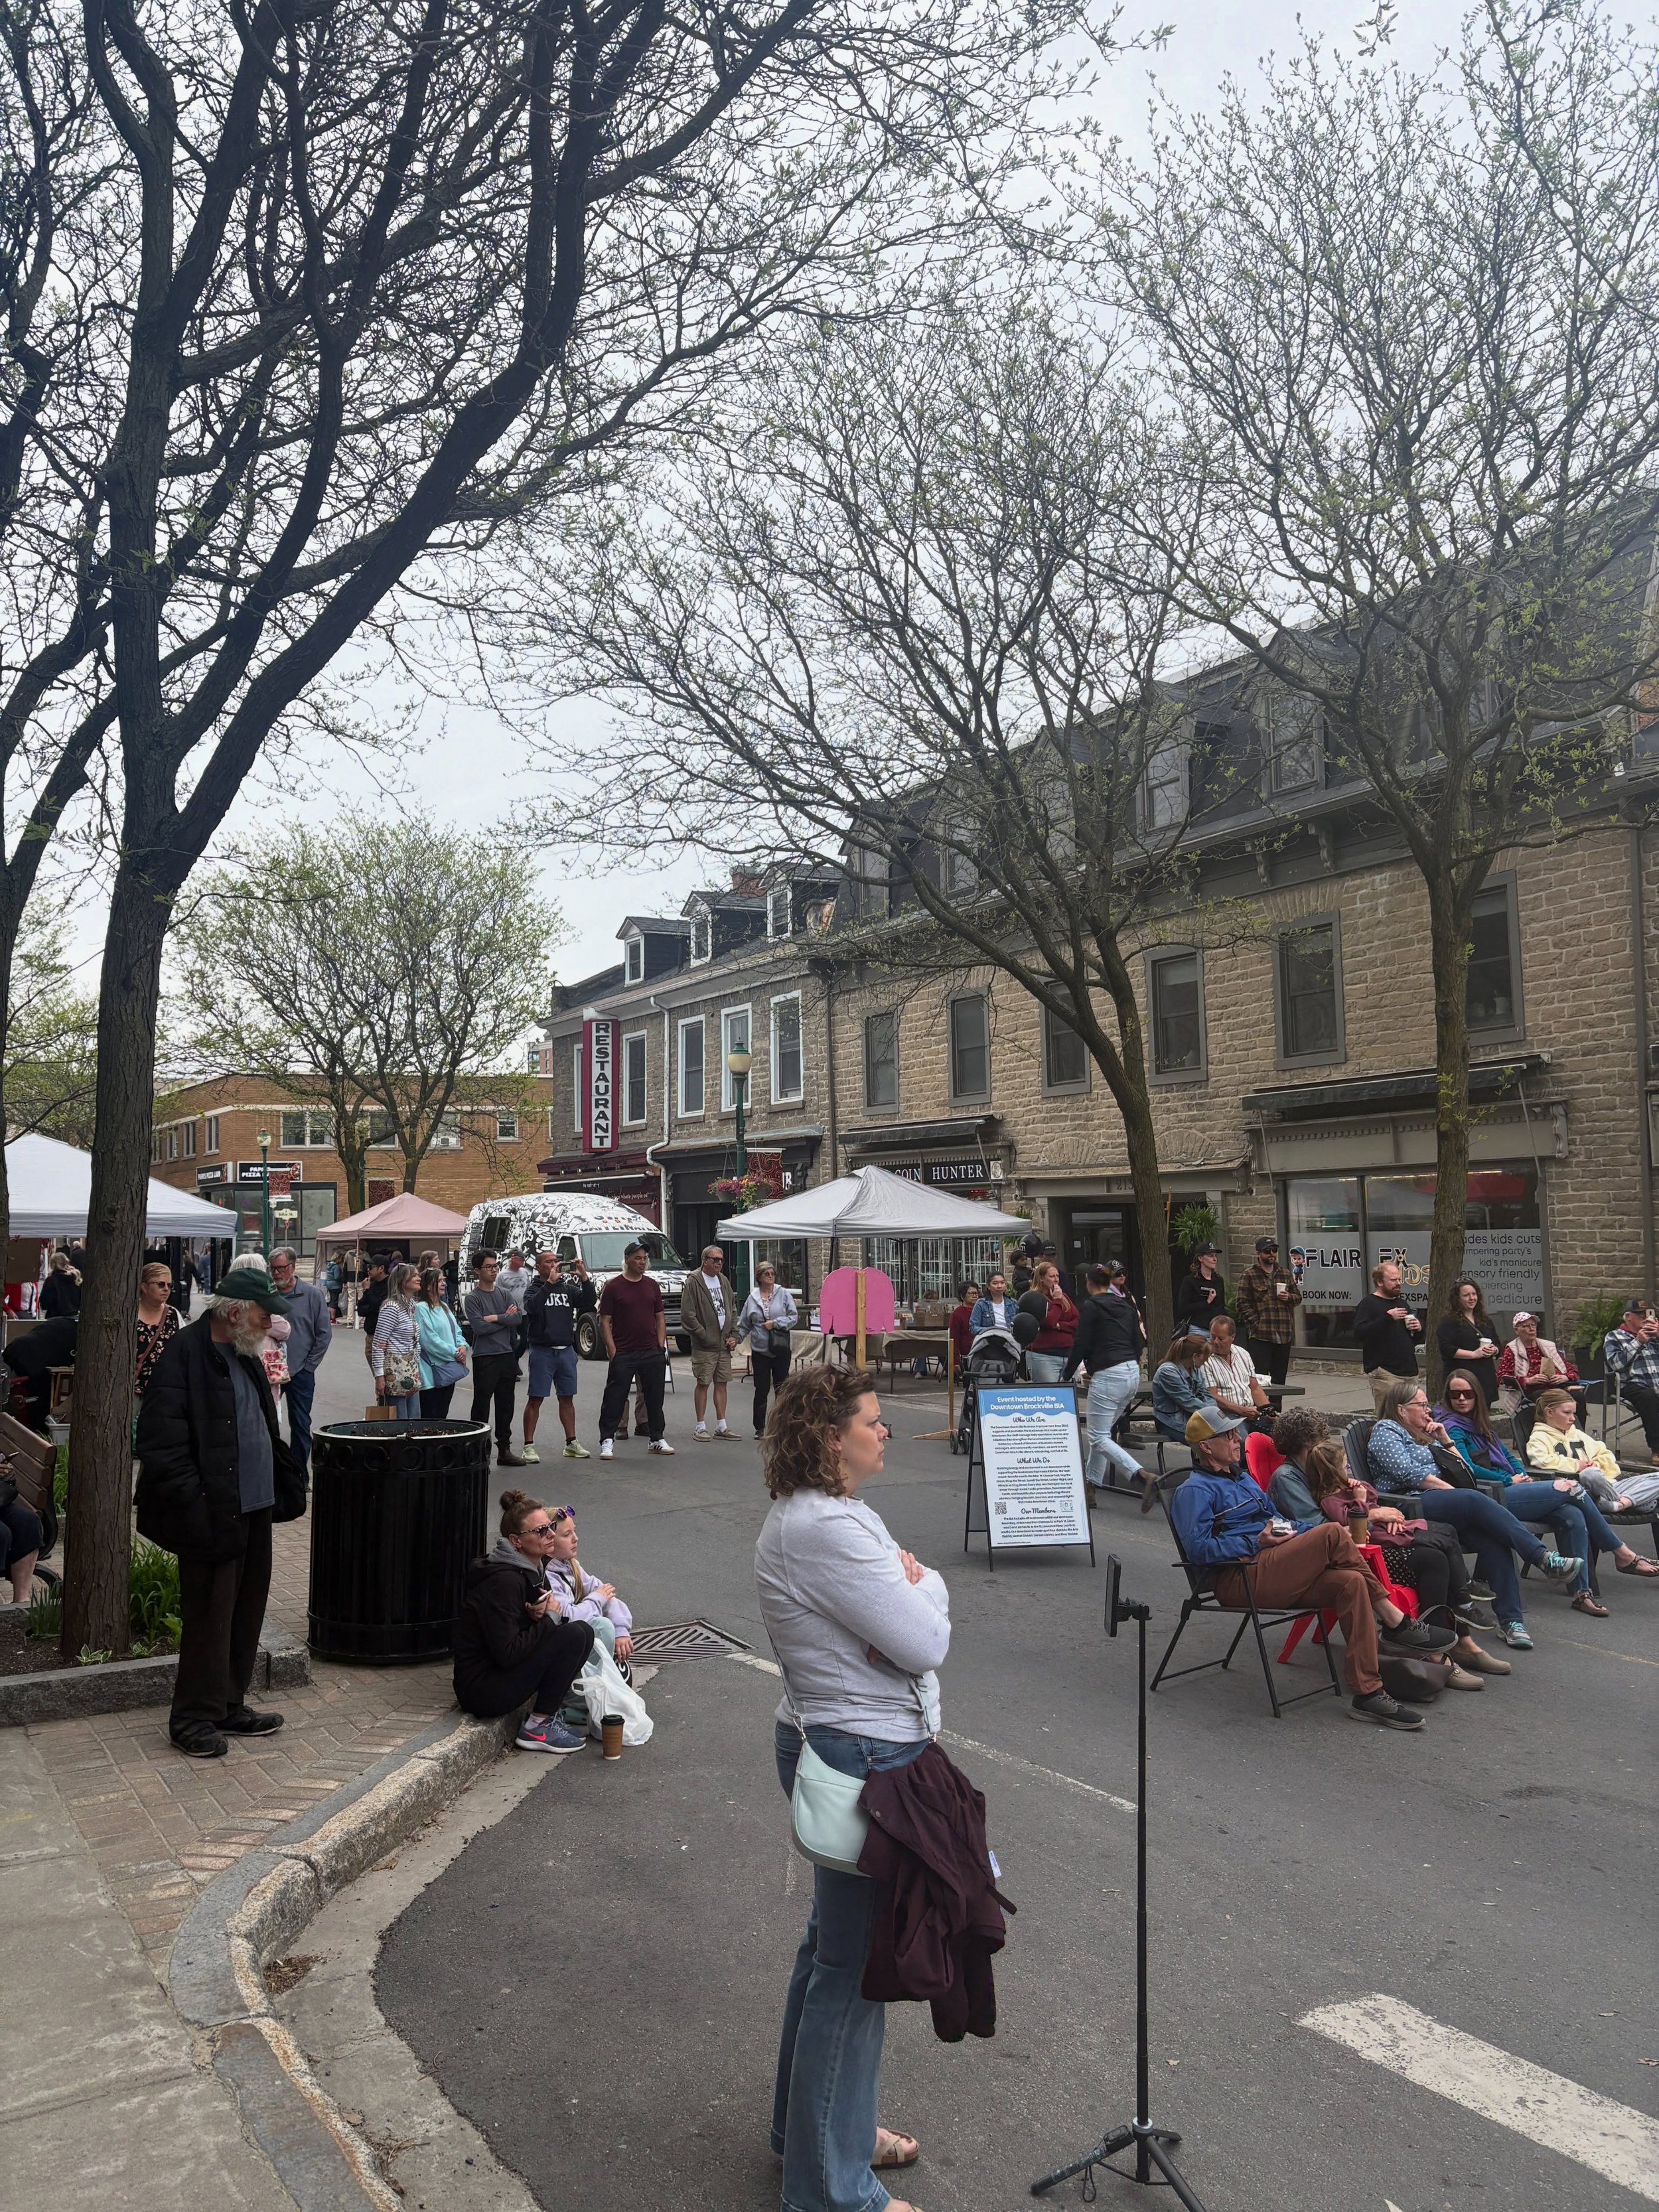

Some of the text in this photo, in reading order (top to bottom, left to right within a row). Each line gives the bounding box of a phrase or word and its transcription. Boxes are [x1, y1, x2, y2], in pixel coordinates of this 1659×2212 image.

[595, 1023, 610, 1146] RESTAURANT
[932, 1164, 983, 1180] HUNTER
[1490, 1234, 1513, 1244] kids
[1516, 1235, 1541, 1244] cuts
[1305, 1248, 1361, 1268] FLAIR
[1502, 1248, 1532, 1256] party's
[1461, 1268, 1540, 1281] ensory friendly
[544, 1293, 570, 1307] UKE
[1302, 1290, 1352, 1299] BOOK NOW:
[1481, 1282, 1542, 1305] piercing pedicure
[1031, 1505, 1056, 1514] Members
